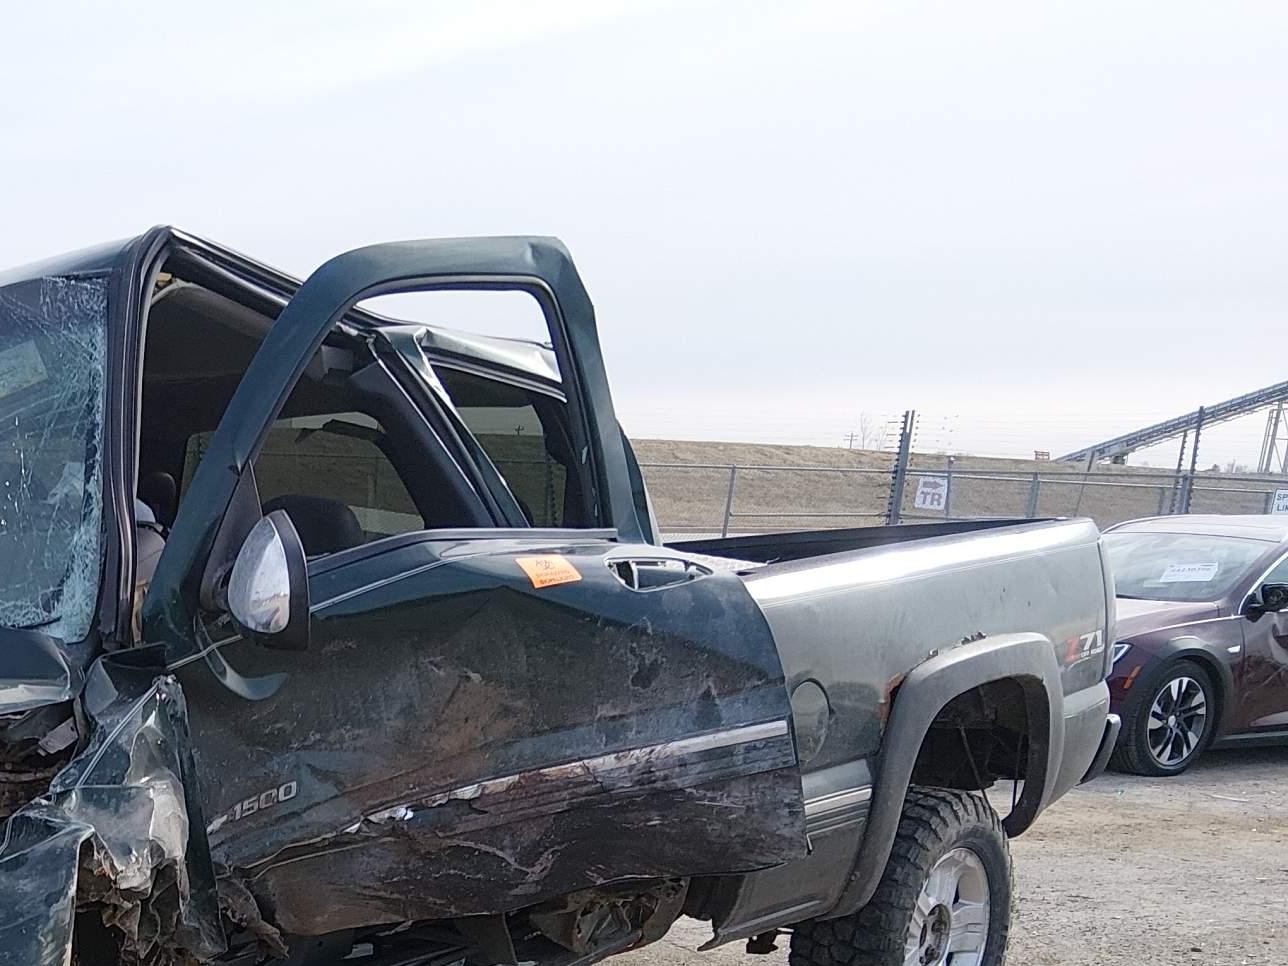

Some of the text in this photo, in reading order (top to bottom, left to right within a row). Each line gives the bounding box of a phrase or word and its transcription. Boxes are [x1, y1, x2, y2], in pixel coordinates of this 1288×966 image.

[920, 490, 943, 506] TR
[1064, 630, 1103, 662] Z71
[233, 781, 297, 821] 1500
